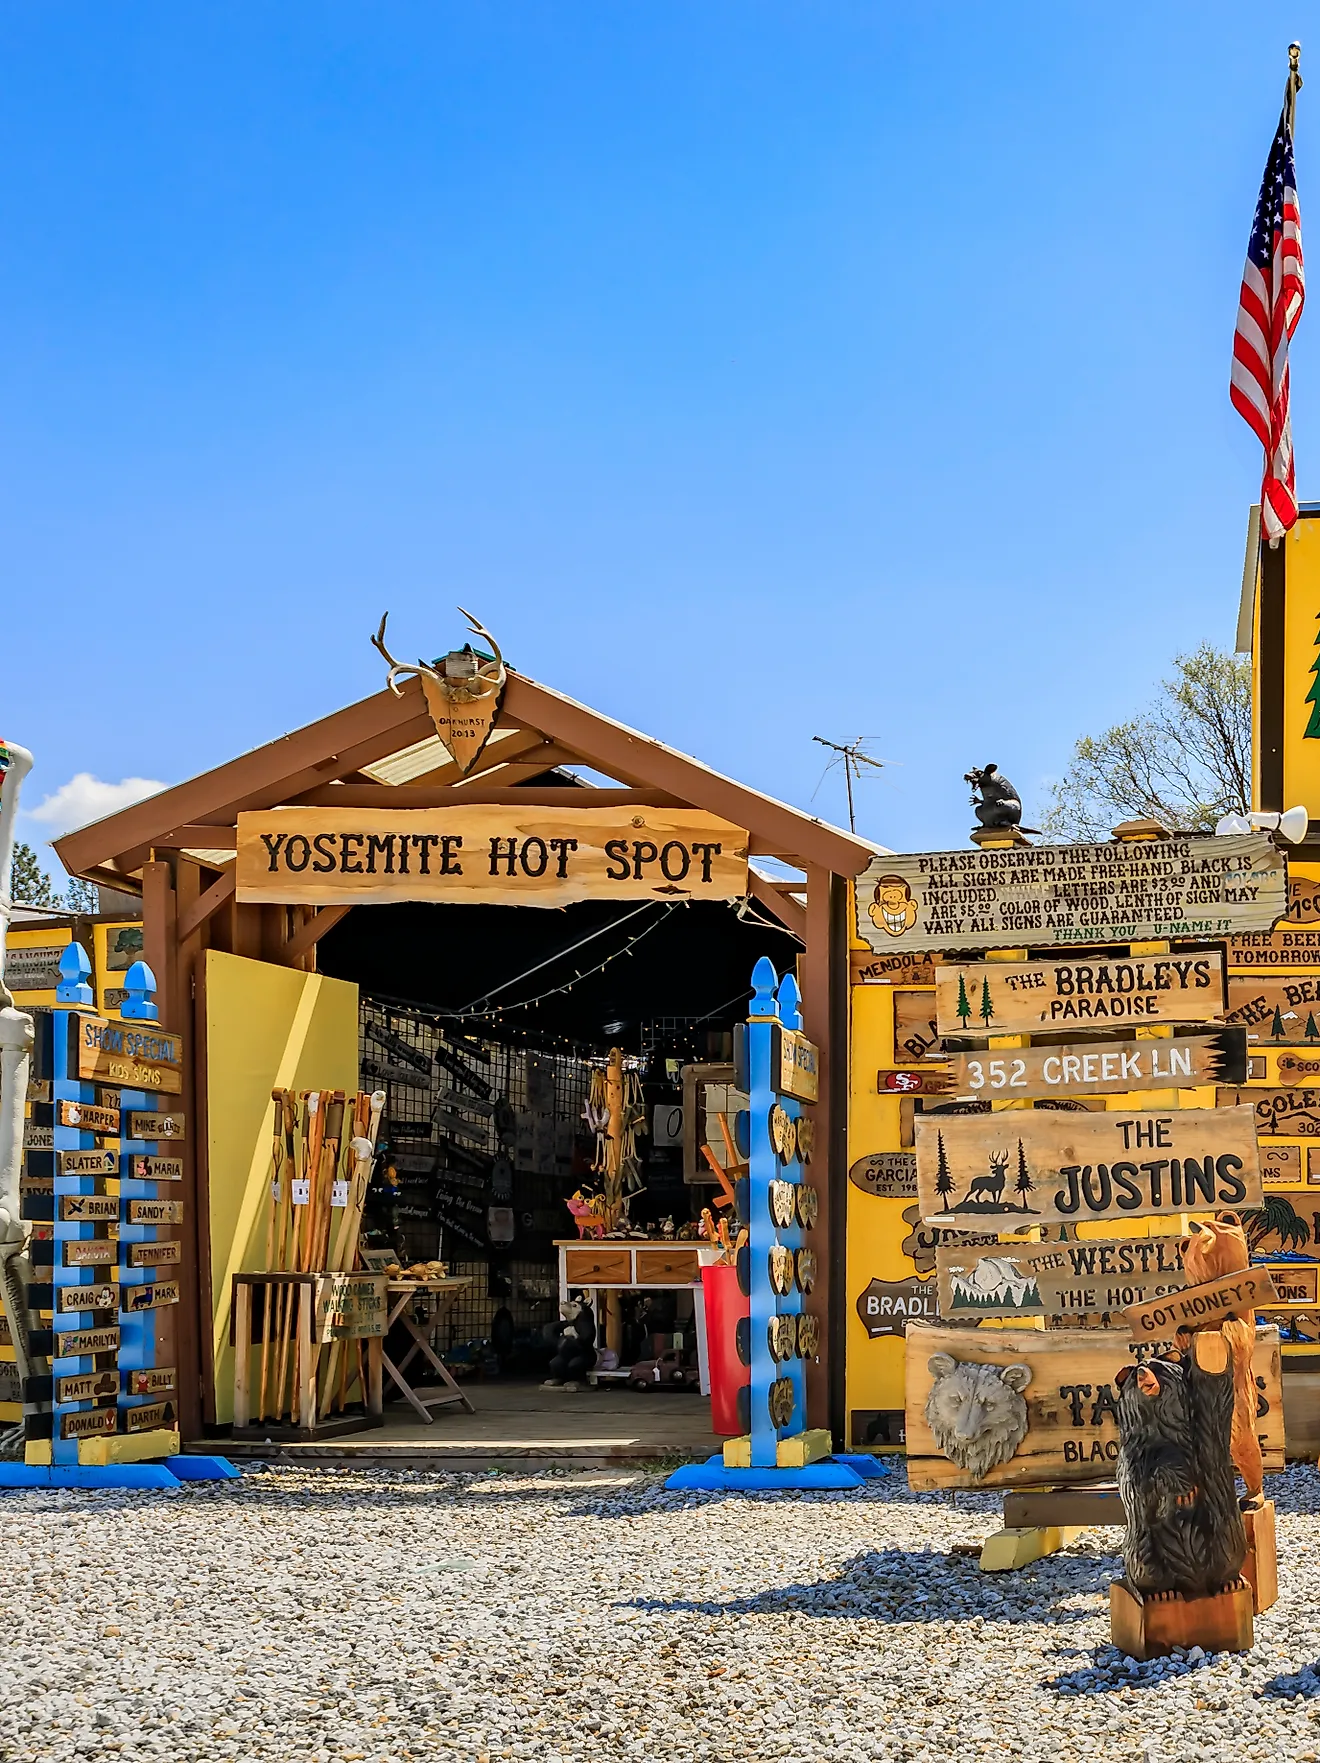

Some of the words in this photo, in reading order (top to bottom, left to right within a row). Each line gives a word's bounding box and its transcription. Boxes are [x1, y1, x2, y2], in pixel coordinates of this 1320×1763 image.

[260, 833, 463, 875] YOSEMITE
[488, 836, 578, 879] HOT
[606, 839, 721, 882] SPOT
[918, 855, 976, 872] PLEASE
[979, 851, 1055, 869] OBSERVED
[1059, 849, 1090, 865] THE
[1094, 843, 1194, 863] FOLLOWING.
[928, 874, 958, 889] ALL
[963, 871, 1006, 886] SIGNS
[1010, 869, 1039, 884] ARE
[1043, 867, 1086, 882] MADE
[1181, 858, 1231, 874] BLACK
[1237, 856, 1252, 871] IS
[1053, 881, 1116, 898] LETTERS
[1119, 879, 1148, 893] ARE
[1190, 875, 1221, 889] AND
[930, 906, 956, 919] ARE
[1000, 901, 1041, 916] COLOR
[1044, 899, 1060, 913] OF
[1115, 892, 1165, 908] LENTH
[1167, 892, 1183, 905] OF
[1186, 890, 1220, 905] SIGN
[1224, 887, 1259, 902] MAY
[1001, 915, 1042, 930] SIGNS
[1046, 914, 1074, 927] ARE
[1053, 927, 1104, 940] THANK
[1154, 920, 1212, 934] U-NAME
[1216, 919, 1232, 930] IT
[1231, 934, 1272, 947] FREE
[858, 954, 933, 981] MENDOLA
[1005, 972, 1047, 991] THE
[1054, 960, 1211, 996] BRADLEYS
[1050, 996, 1159, 1020] PARADISE
[1225, 996, 1274, 1028] THE
[84, 1023, 124, 1054] SHOW
[126, 1032, 179, 1065] SPECIAL
[108, 1062, 129, 1080] KIDS
[133, 1067, 161, 1085] SIGNS
[967, 1059, 1027, 1089] 352
[1042, 1050, 1143, 1086] CREEK
[83, 1110, 114, 1126] HARPER
[136, 1120, 156, 1132] MIKE
[1116, 1117, 1175, 1150] THE
[66, 1157, 102, 1169] SLATER
[154, 1162, 180, 1175] MARIA
[888, 1158, 909, 1166] THE
[876, 1184, 894, 1192] EST.
[1054, 1153, 1247, 1214] JUSTINS
[88, 1202, 117, 1214] BRIAN
[137, 1206, 165, 1218] SANDY
[138, 1247, 176, 1260] JENNIFER
[1027, 1251, 1066, 1273] THE
[155, 1286, 176, 1299] MARK
[911, 1286, 933, 1295] THE
[1056, 1289, 1096, 1308] THE
[1107, 1287, 1147, 1306] HOT
[66, 1292, 94, 1306] CRAIG
[1139, 1306, 1176, 1332] GOT
[1178, 1281, 1257, 1316] HONEY?
[79, 1333, 117, 1349] MARILYN
[151, 1374, 173, 1386] BILLY
[65, 1381, 92, 1396] MATT
[68, 1417, 103, 1432] DONALD
[131, 1409, 160, 1425] DARTH
